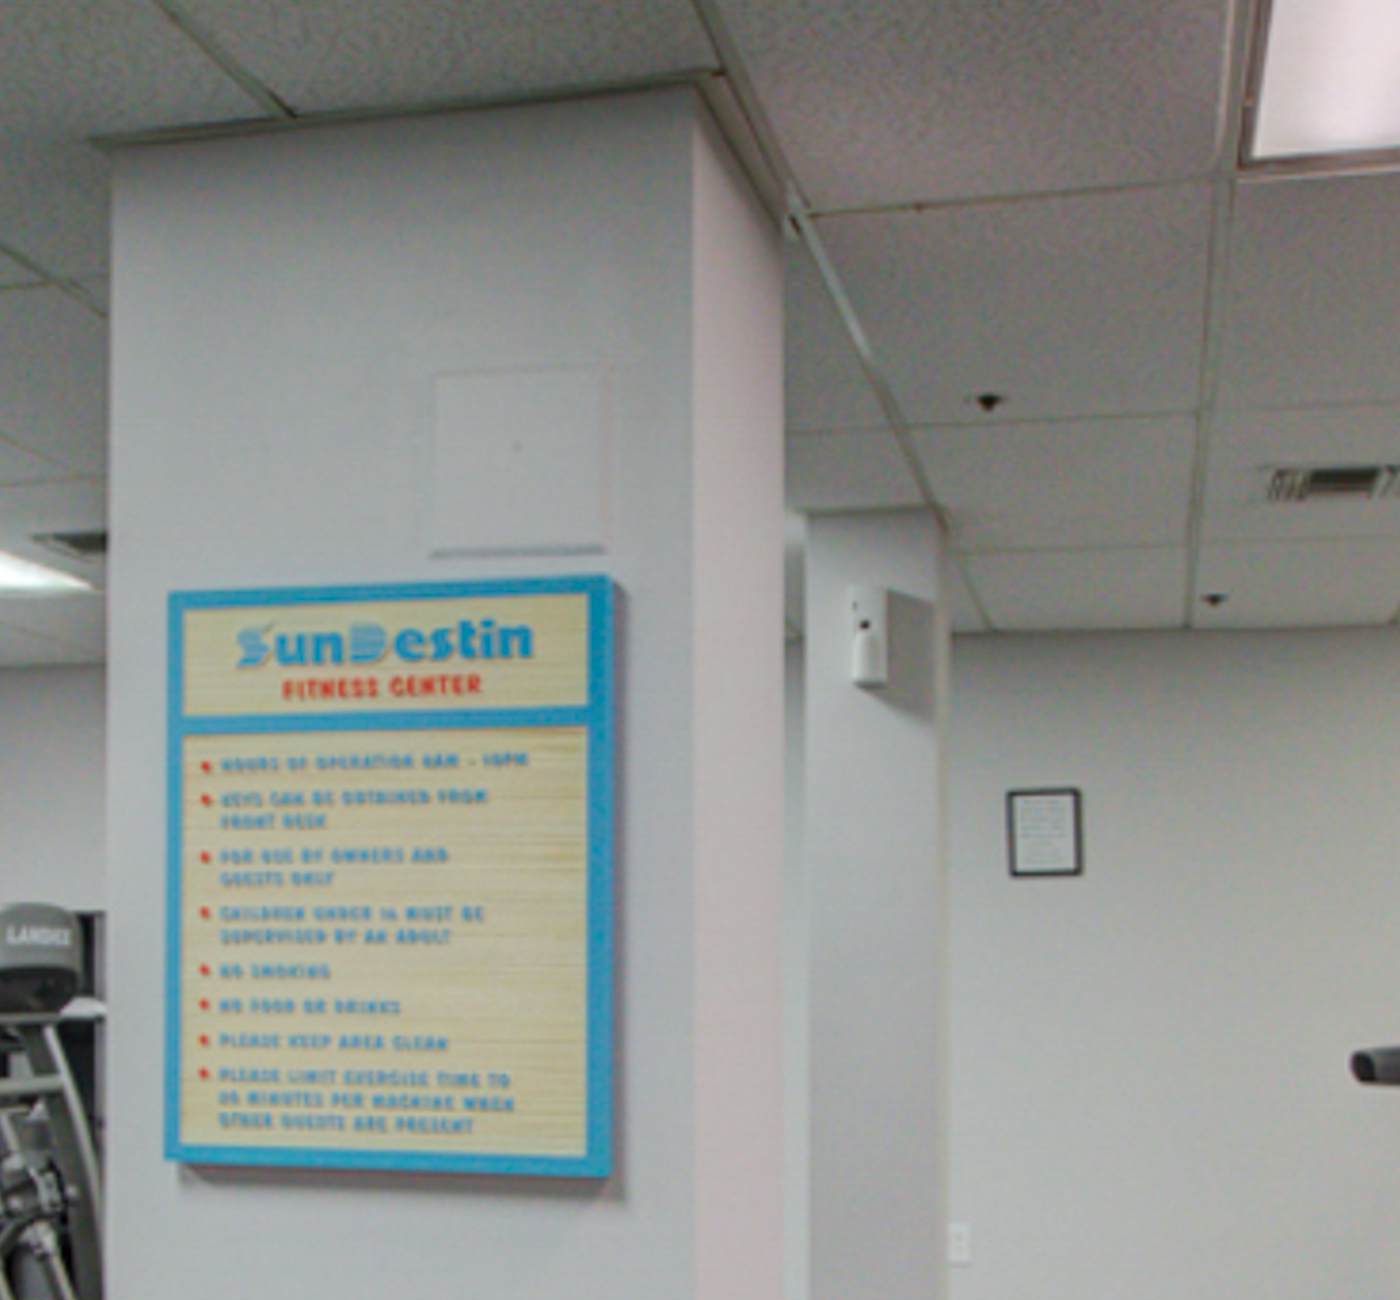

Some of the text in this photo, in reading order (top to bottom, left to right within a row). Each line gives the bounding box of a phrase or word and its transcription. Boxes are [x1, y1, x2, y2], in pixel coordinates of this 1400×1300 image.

[236, 618, 533, 668] SunDestin
[281, 673, 482, 700] FITNESS CENTER
[219, 756, 279, 772] HOURS
[286, 755, 308, 771] OF
[316, 753, 414, 770] OPERATION
[482, 751, 529, 768] 10PM
[220, 787, 489, 808] KEYS CAN BE OBTAINED FROM
[219, 813, 328, 830] FRONT DESK
[219, 847, 449, 864] FOR USE BY OWNERS AND
[218, 871, 335, 887] GUESTS ONLY
[218, 906, 305, 922] CHILDREN
[313, 905, 372, 921] UNDER
[404, 905, 454, 922] MUST
[460, 904, 485, 922] BE
[218, 928, 451, 944] SUPERVISED BY AN ADULT
[219, 962, 331, 979] NO SMOKING
[219, 998, 402, 1016] NO FOOD OR DRINKS
[218, 1031, 449, 1051] PLEASE KEEP AREA CLEAN
[218, 1067, 512, 1089] PLEASE LIMIT EXERCISE TIME TO
[247, 1091, 323, 1107] MINUTES
[331, 1092, 364, 1107] PER
[372, 1094, 454, 1110] MACHINE
[463, 1095, 516, 1112] WHEN
[218, 1111, 475, 1132] OTHER GUESTS ARE PRESENT
